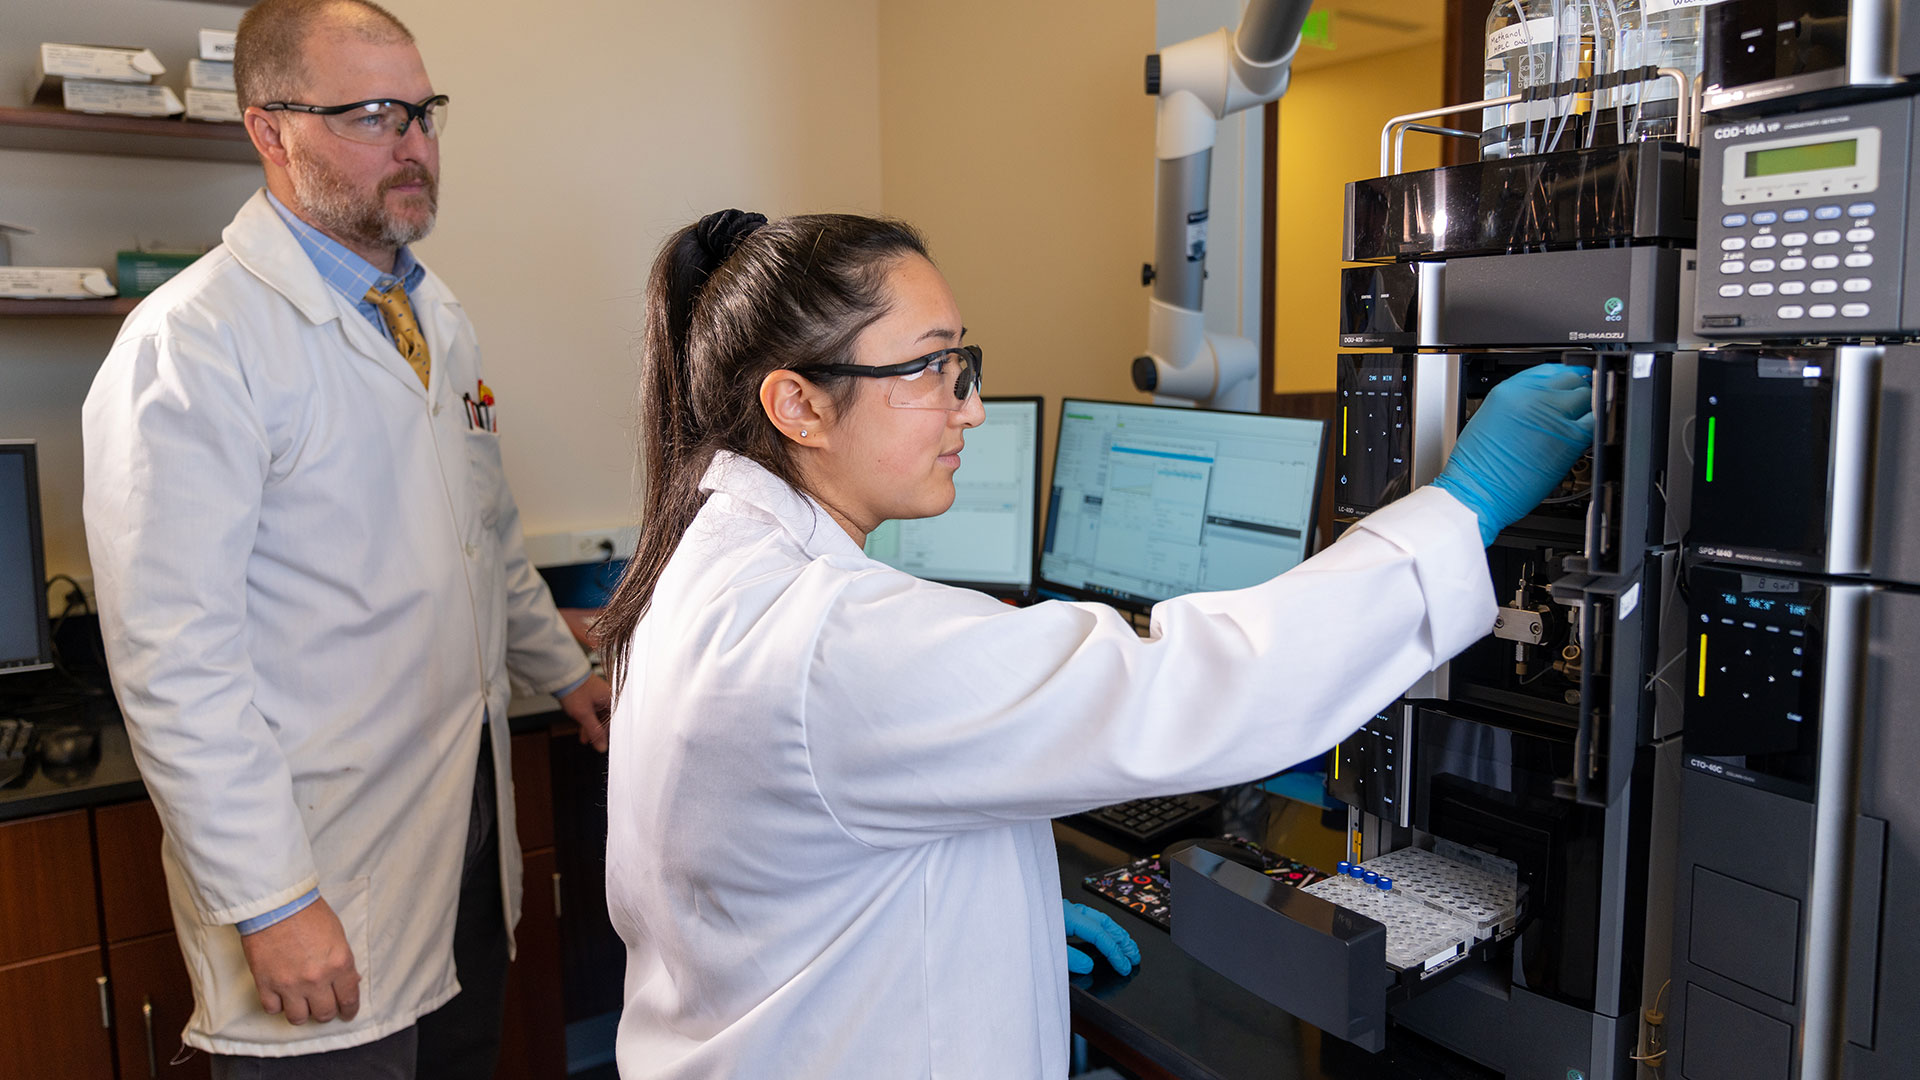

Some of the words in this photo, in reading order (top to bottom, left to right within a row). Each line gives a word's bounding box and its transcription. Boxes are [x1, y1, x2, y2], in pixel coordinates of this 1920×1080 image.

[1491, 29, 1521, 44] Methanol
[1520, 64, 1543, 72] SCOTT
[1518, 79, 1545, 88] DUAN
[1714, 123, 1766, 140] CDD-10A
[1690, 758, 1723, 774] CTO-40C
